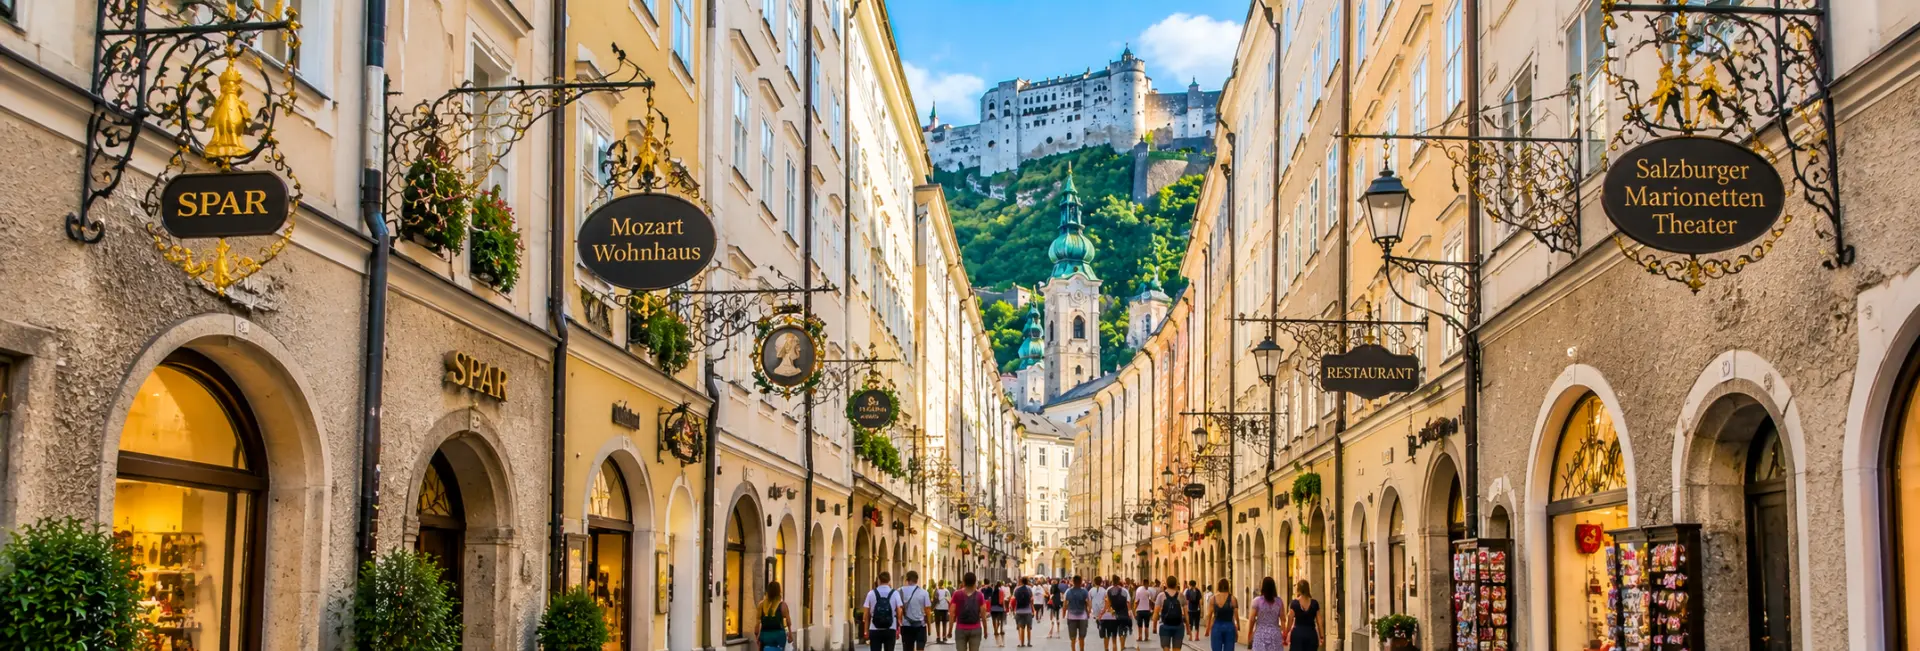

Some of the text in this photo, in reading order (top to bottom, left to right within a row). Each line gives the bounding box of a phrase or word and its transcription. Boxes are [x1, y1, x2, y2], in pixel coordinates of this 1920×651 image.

[1636, 158, 1750, 185] Salzburger
[177, 189, 269, 217] SPAR
[1625, 184, 1766, 208] Marionetten
[610, 217, 684, 236] Mozart
[1652, 213, 1738, 235] Theater
[593, 242, 702, 262] Wohnhaus
[447, 351, 508, 401] SPAR
[1327, 366, 1414, 380] RESTAURANT
